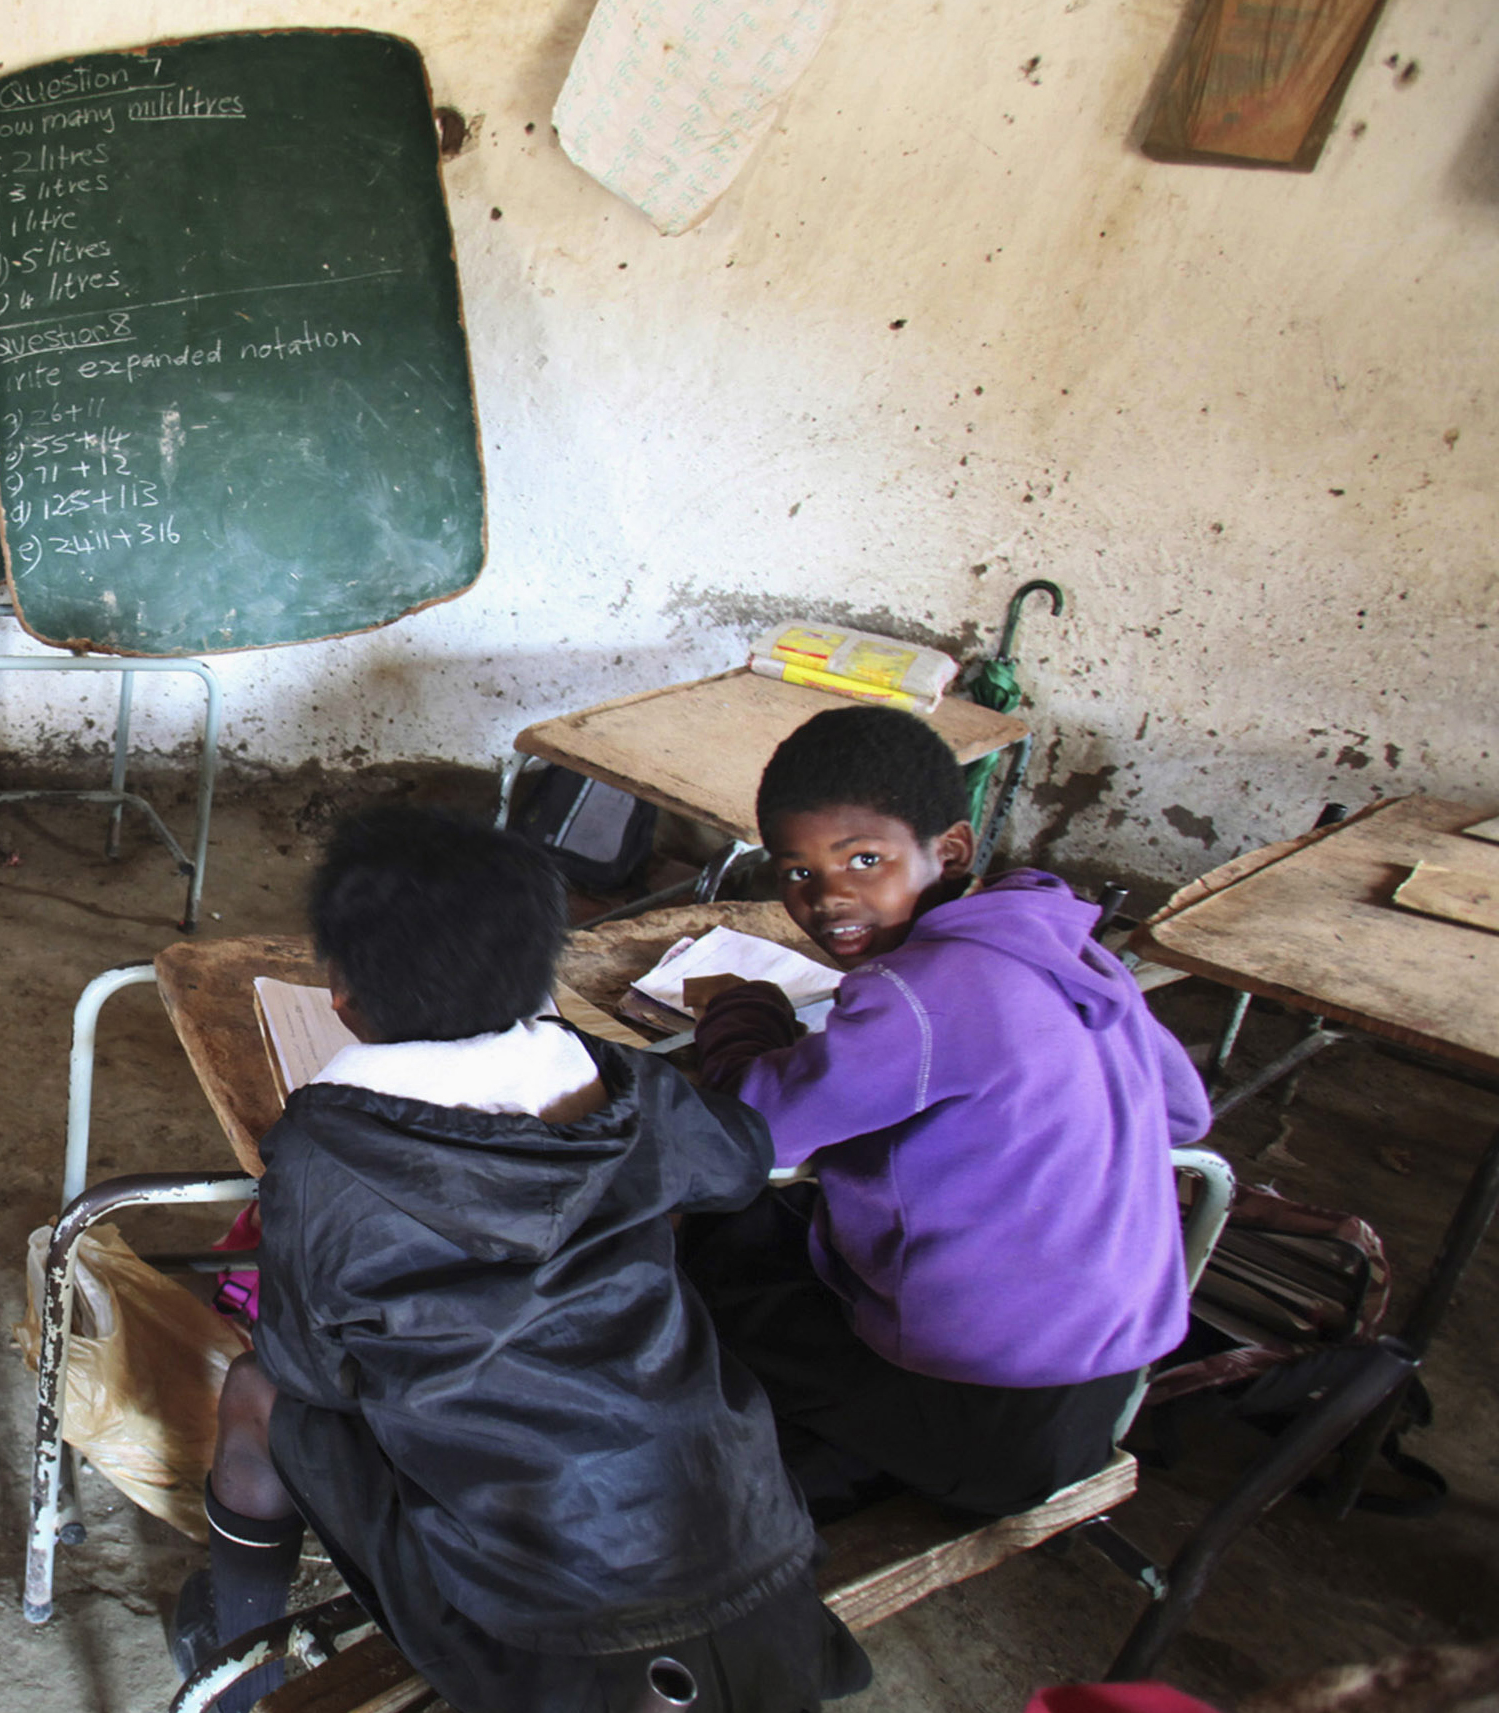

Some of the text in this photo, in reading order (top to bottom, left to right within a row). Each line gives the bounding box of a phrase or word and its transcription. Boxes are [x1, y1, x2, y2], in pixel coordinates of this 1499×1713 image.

[139, 58, 162, 75] 7
[42, 104, 115, 133] many
[49, 270, 120, 300] litres
[78, 338, 222, 383] expanded
[241, 320, 362, 360] notation
